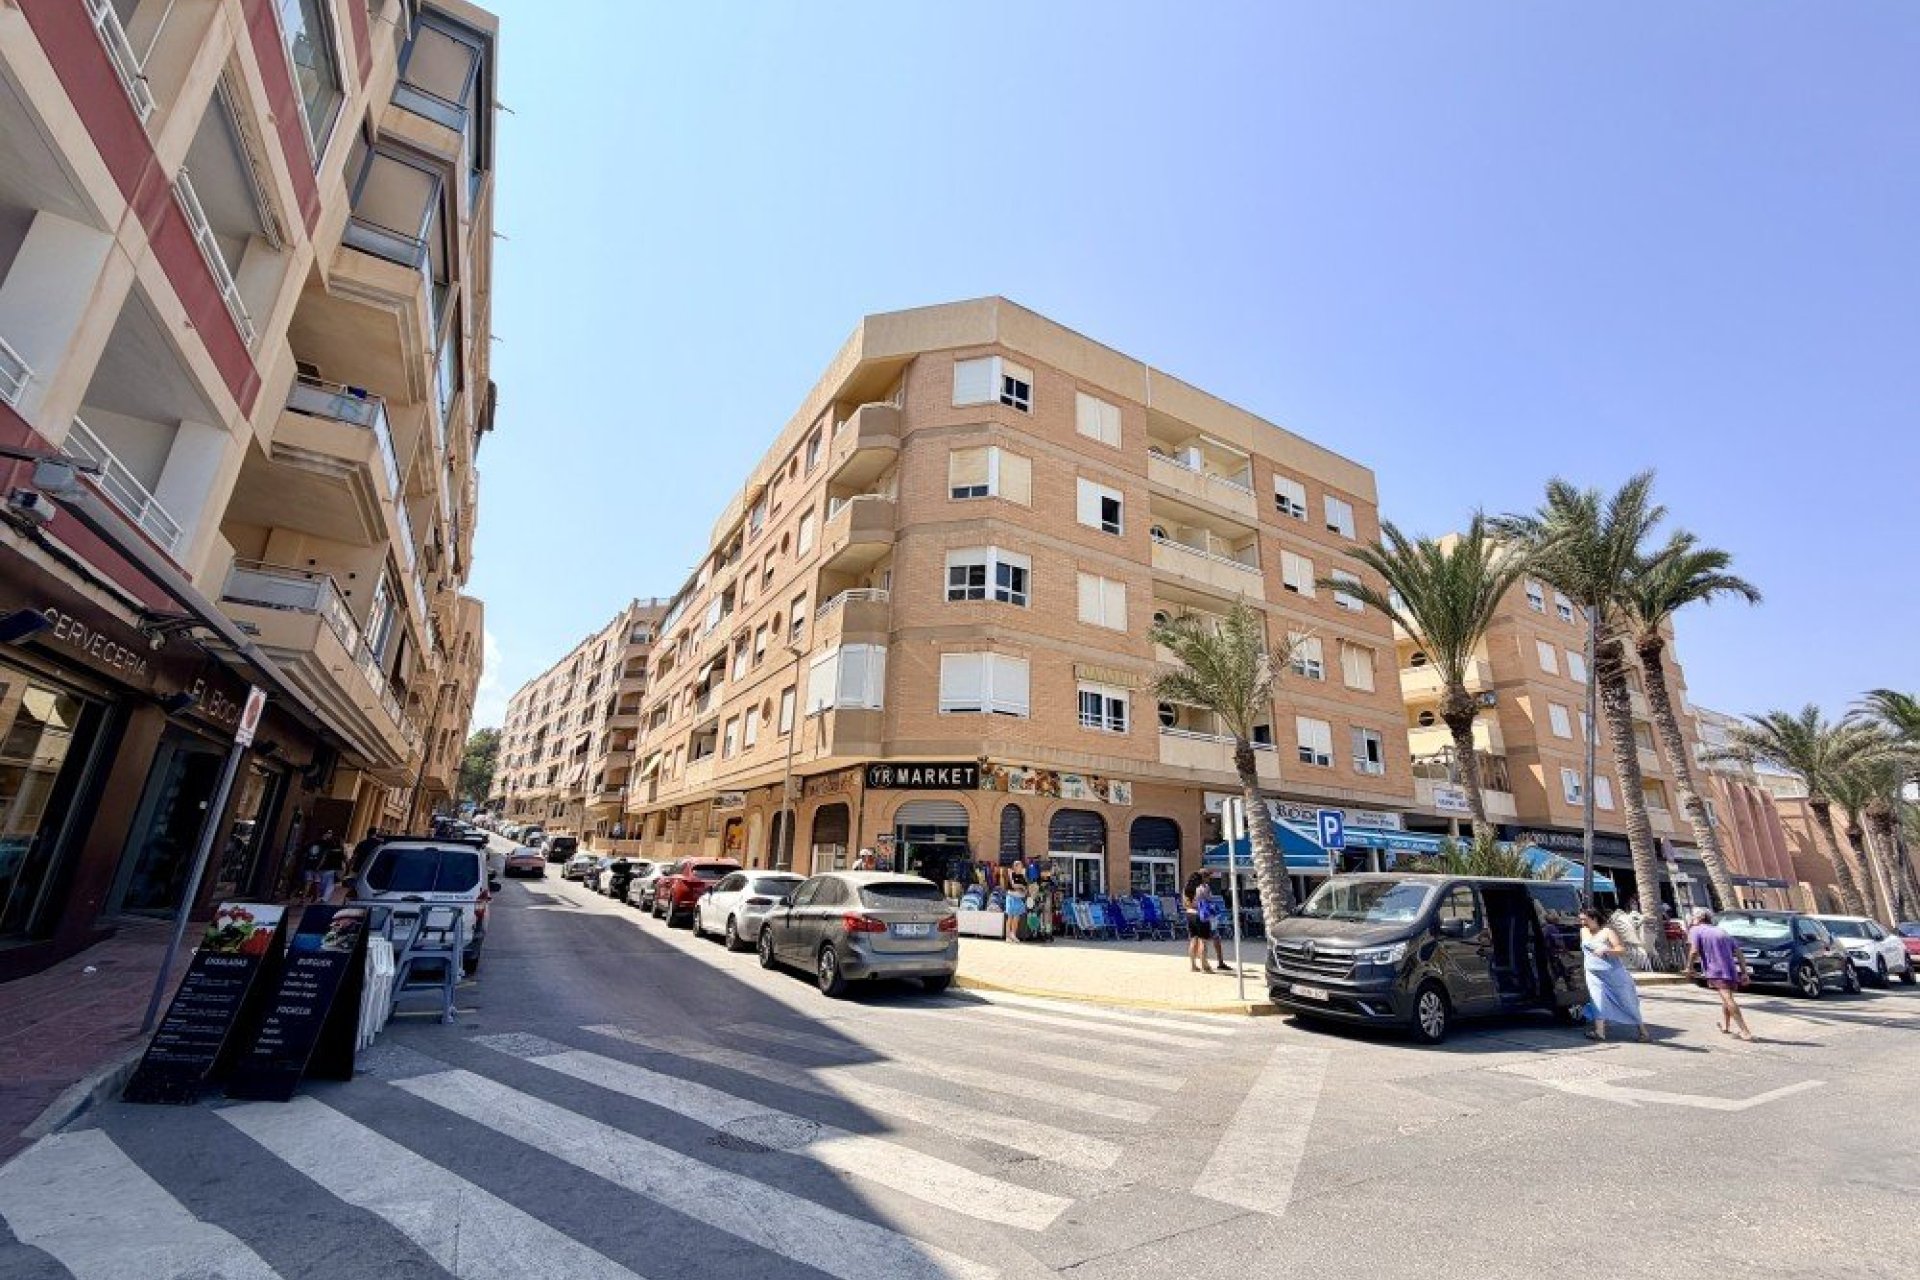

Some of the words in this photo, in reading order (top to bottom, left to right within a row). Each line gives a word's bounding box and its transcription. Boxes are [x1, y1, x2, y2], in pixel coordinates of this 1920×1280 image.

[43, 607, 147, 676] CERVECERIA
[896, 767, 975, 785] MARKET
[1323, 815, 1338, 845] P
